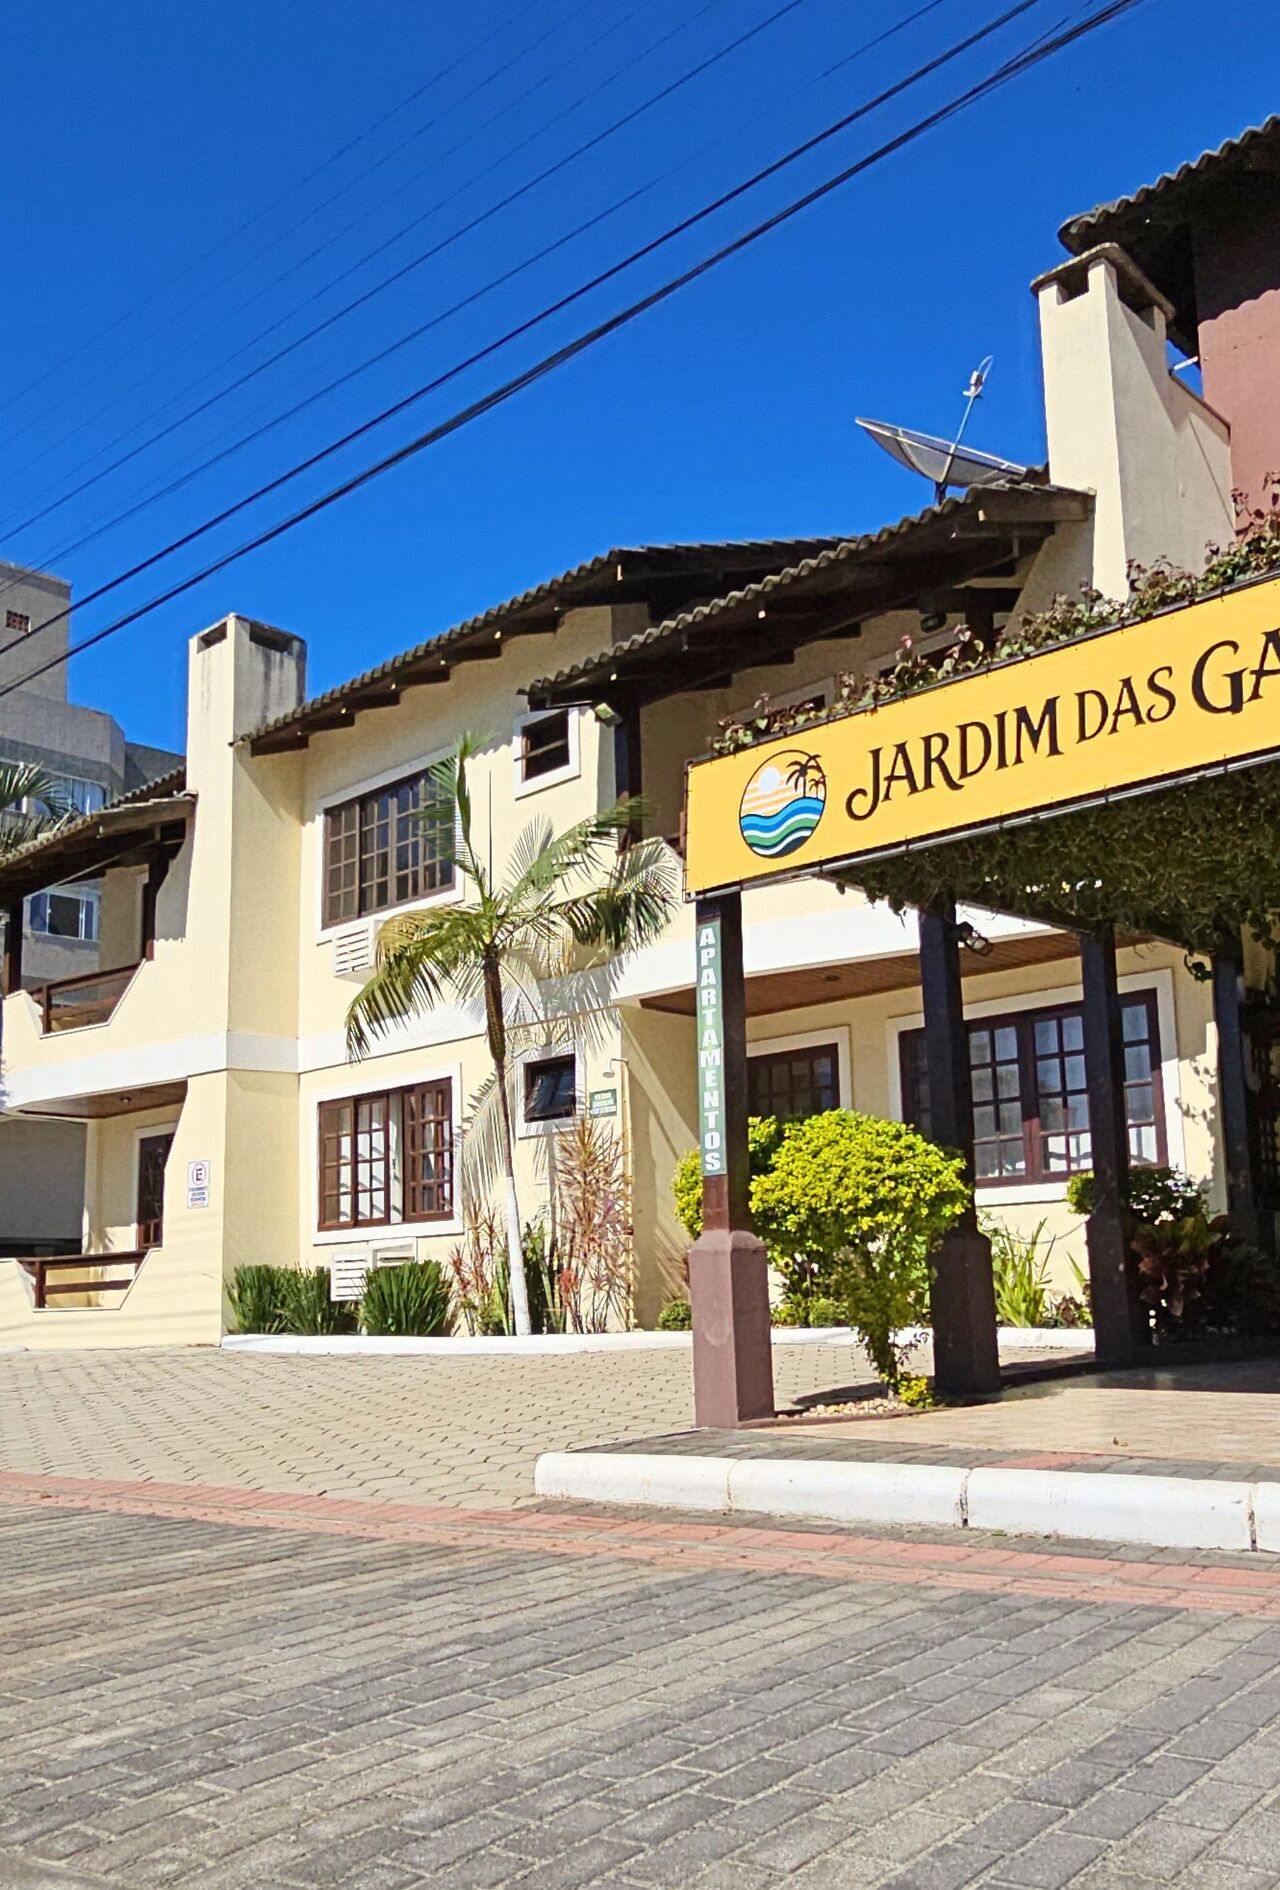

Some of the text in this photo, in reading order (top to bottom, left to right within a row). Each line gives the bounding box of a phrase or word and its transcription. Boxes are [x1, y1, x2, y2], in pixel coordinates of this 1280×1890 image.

[846, 694, 1064, 821] JARDIM
[1075, 666, 1176, 744] DAS
[699, 927, 721, 1171] APARTAMENTOS
[195, 1167, 203, 1182] E
